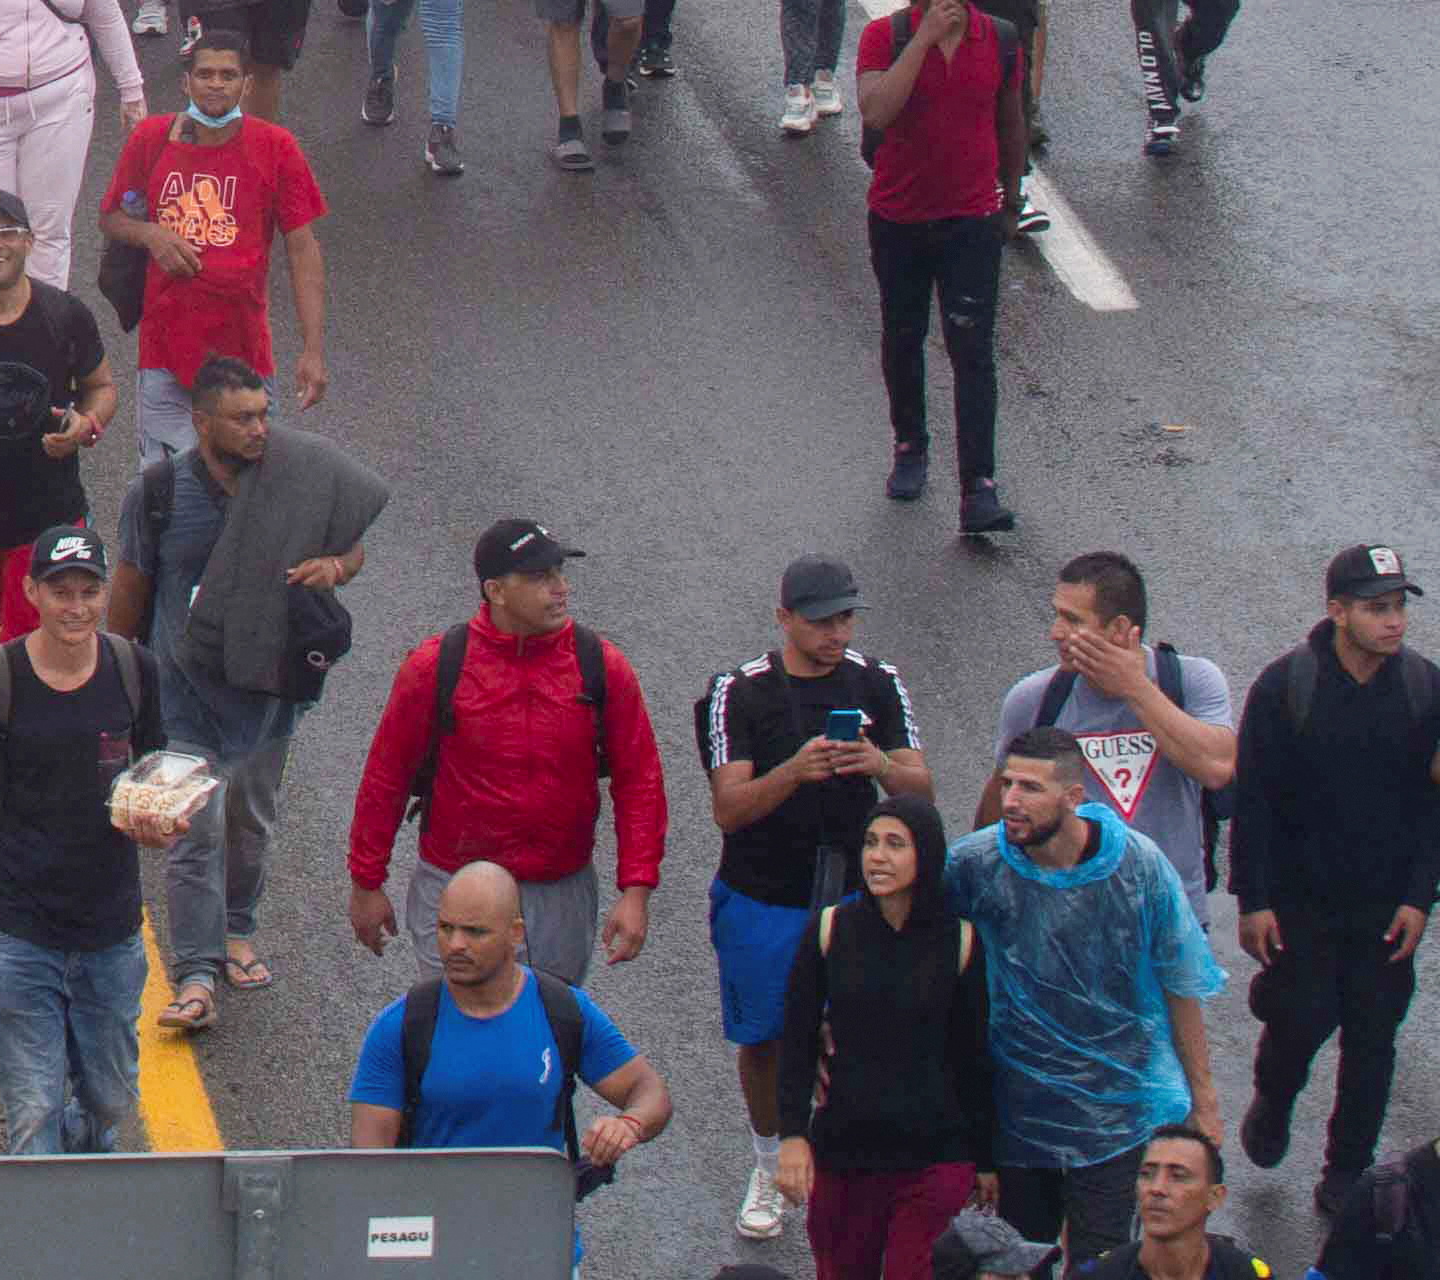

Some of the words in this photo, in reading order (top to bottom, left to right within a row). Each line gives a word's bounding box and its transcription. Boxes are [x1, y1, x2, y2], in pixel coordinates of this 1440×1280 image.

[1137, 30, 1157, 69] OLD
[1145, 70, 1172, 113] NAVY
[56, 537, 86, 552] NIKE
[1084, 735, 1156, 761] GUESS
[370, 1231, 430, 1243] PESAGU
